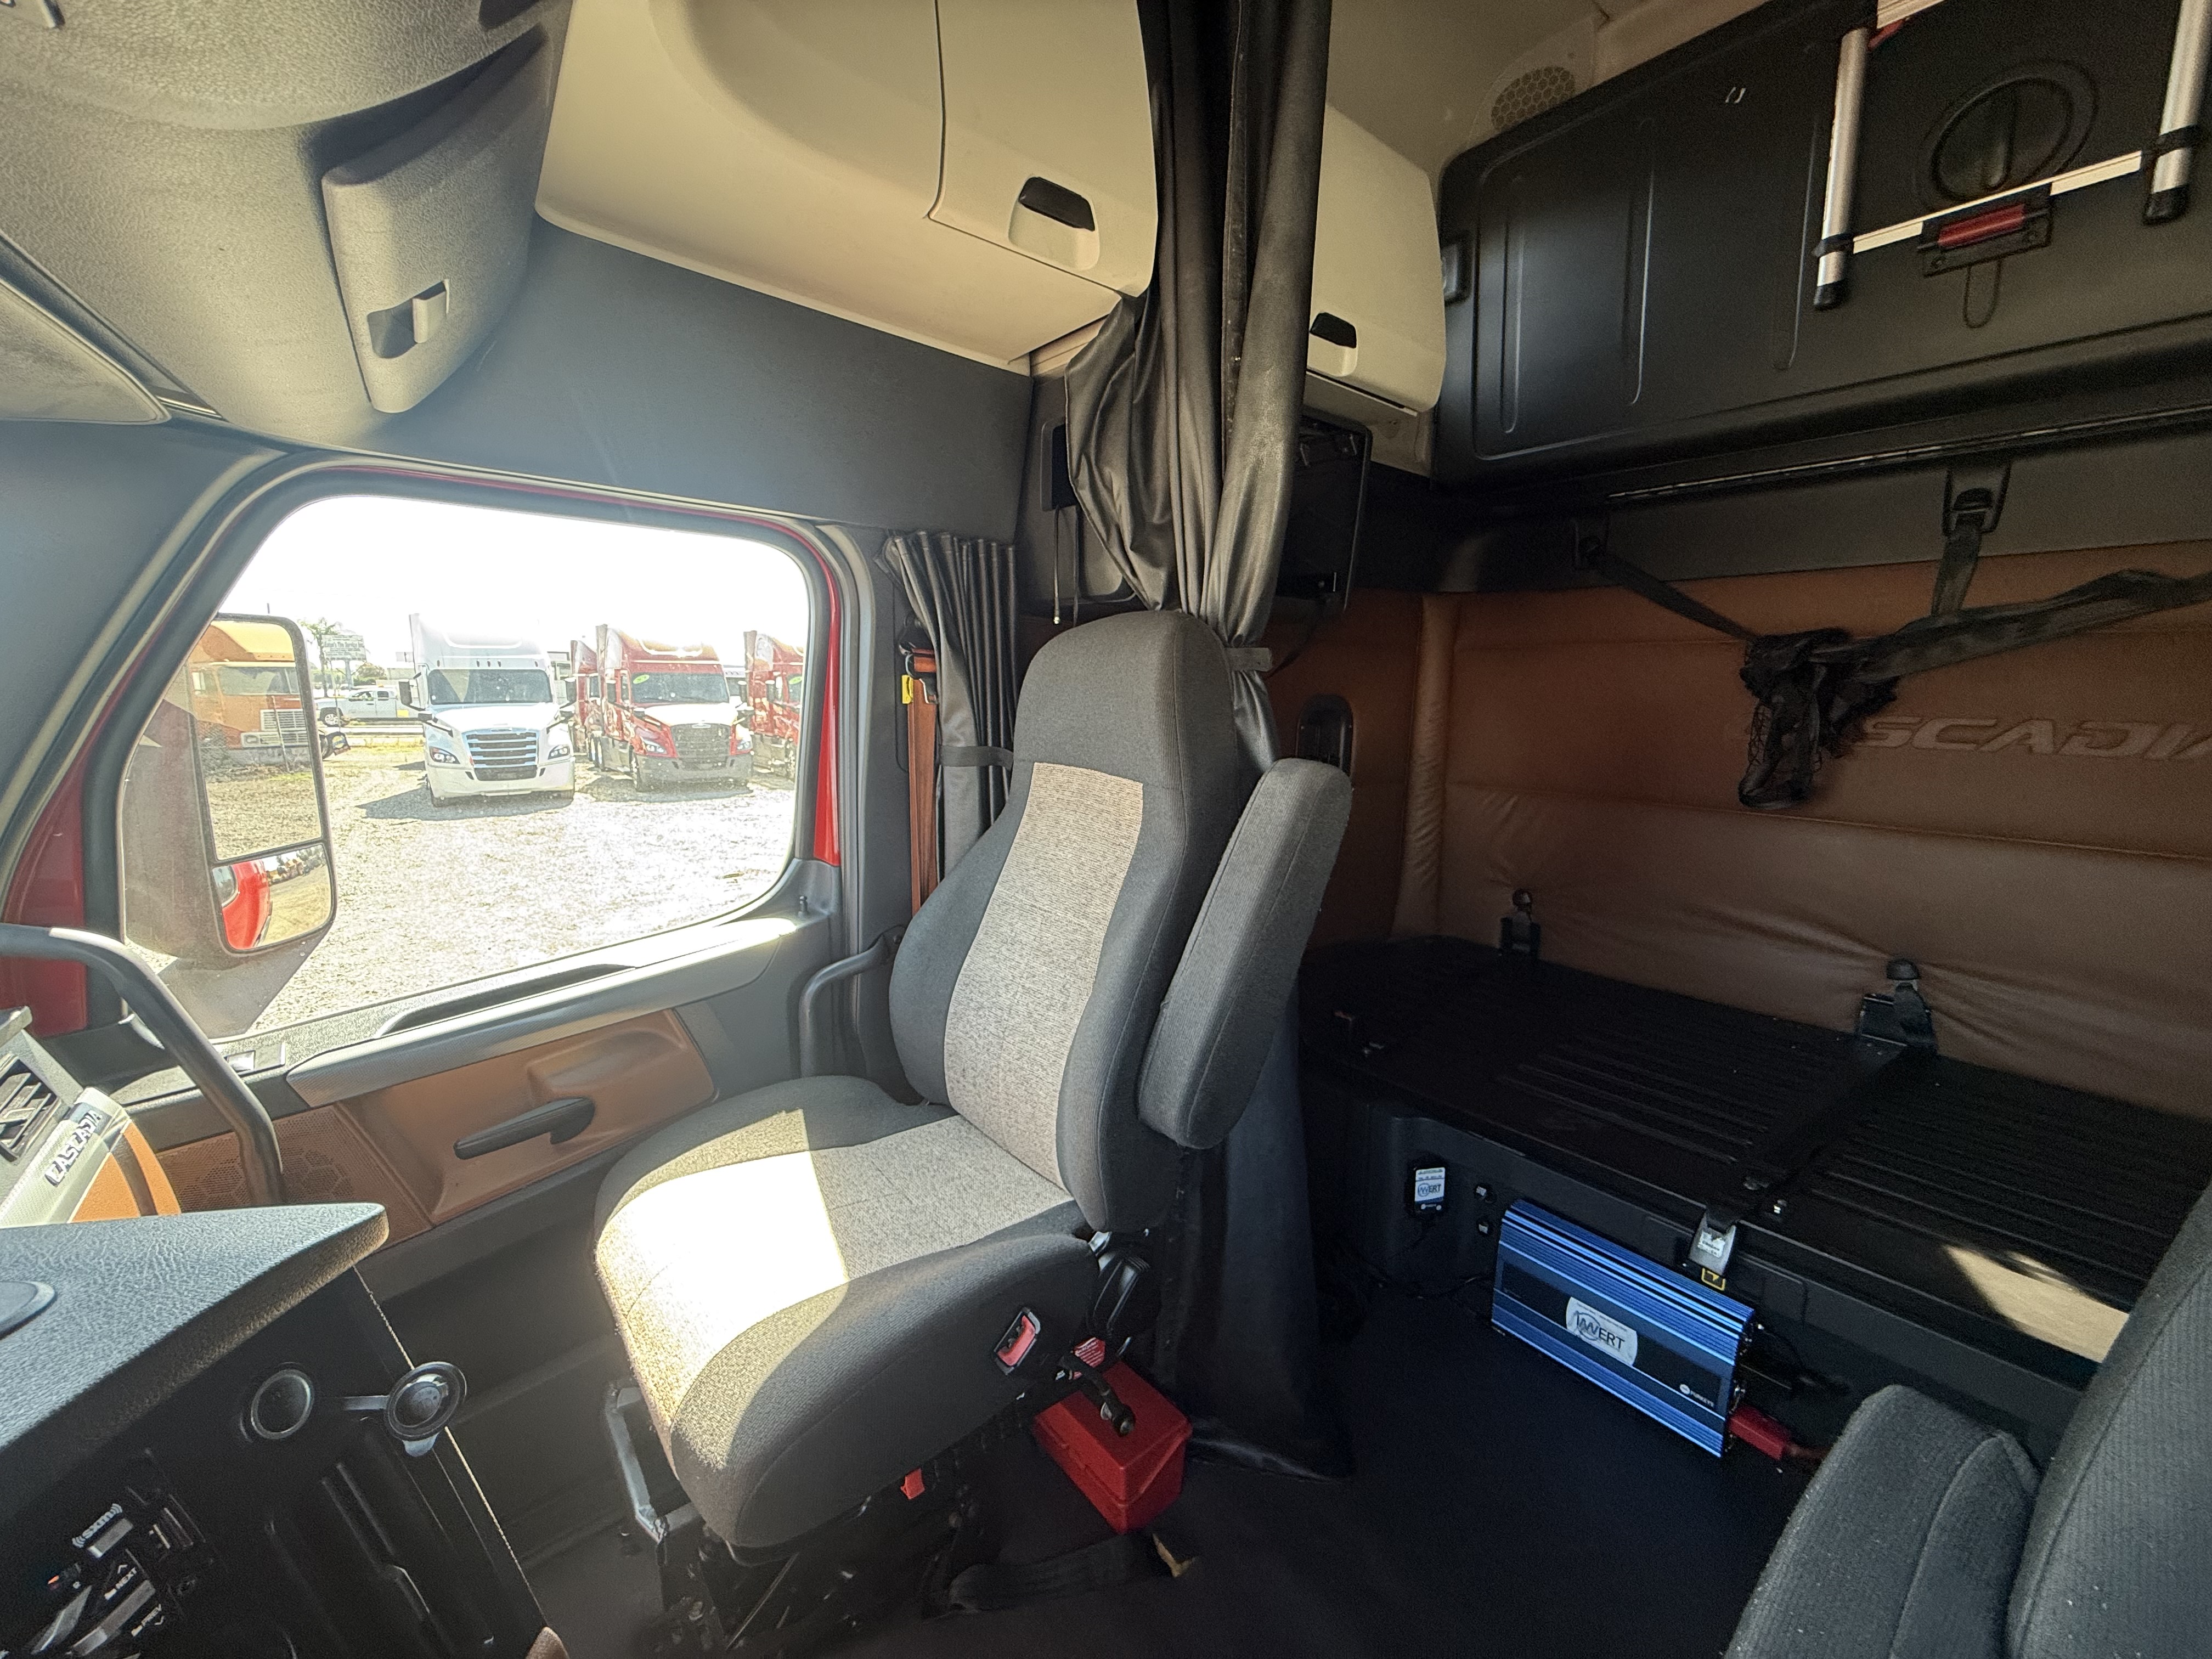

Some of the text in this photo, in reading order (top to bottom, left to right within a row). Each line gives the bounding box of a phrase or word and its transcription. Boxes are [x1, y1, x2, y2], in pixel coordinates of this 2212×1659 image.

[44, 1109, 103, 1185] CASCADIA
[115, 1567, 137, 1590] NEXT
[141, 1603, 162, 1627] PREV
